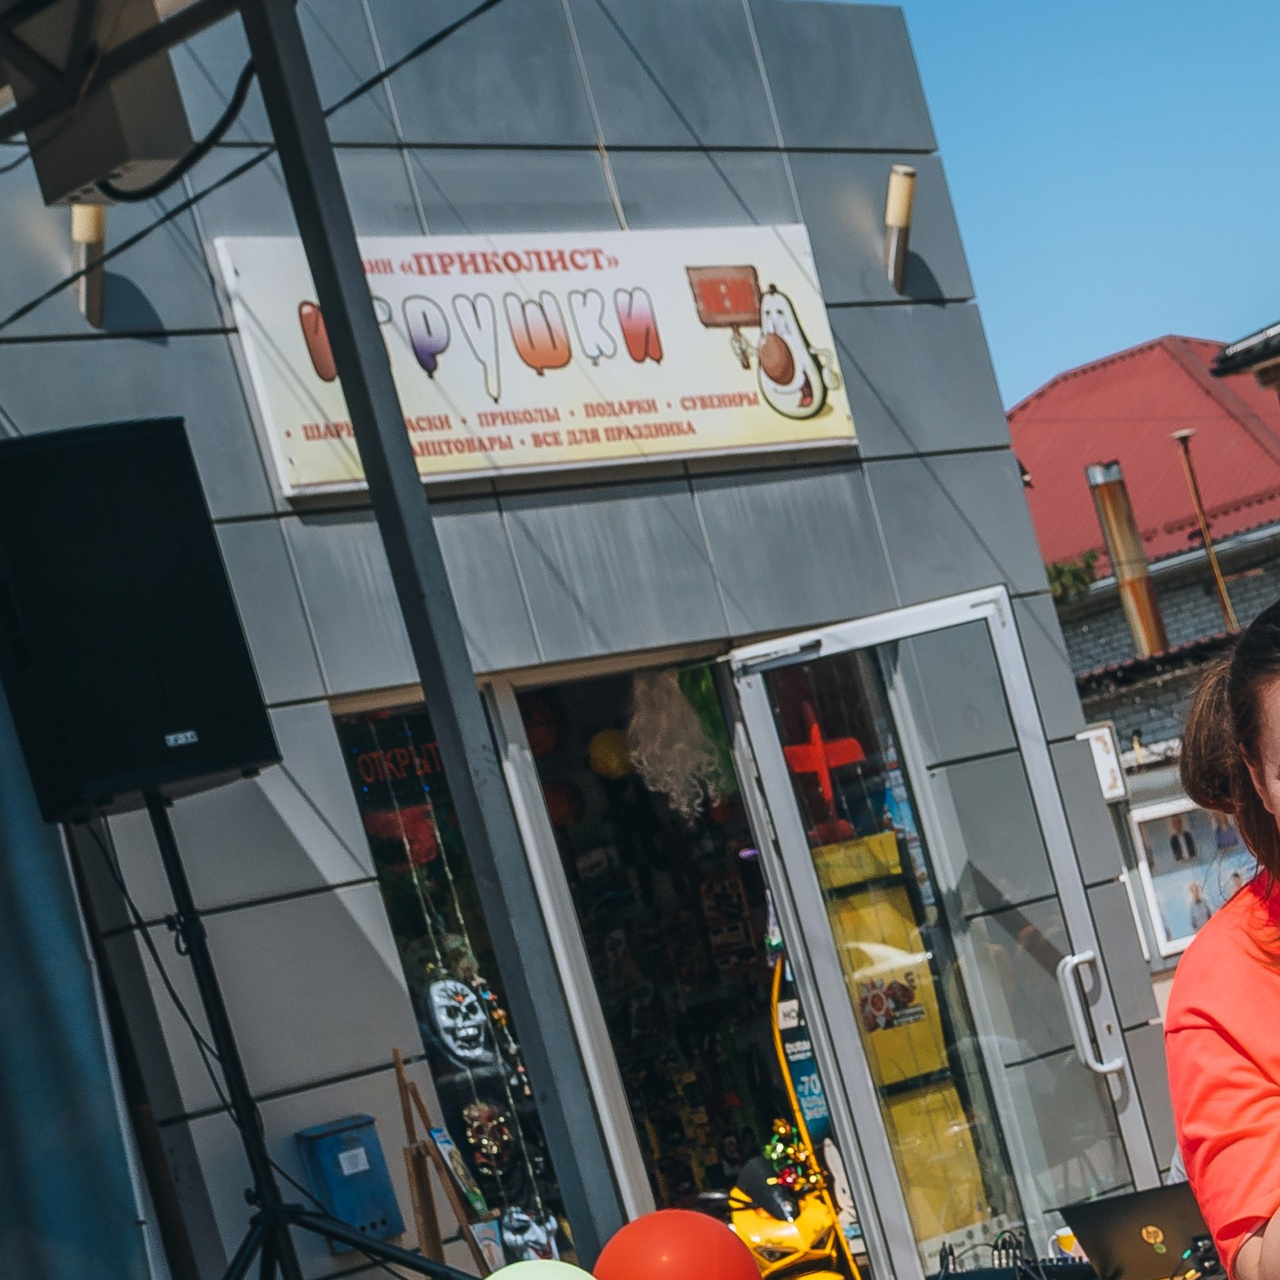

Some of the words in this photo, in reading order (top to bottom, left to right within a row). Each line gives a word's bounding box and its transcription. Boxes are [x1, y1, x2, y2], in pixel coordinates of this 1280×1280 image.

[298, 287, 663, 404] ИРУШКИ
[403, 414, 453, 433] АСКИ
[477, 406, 561, 428] ПРИКОЛЫ
[583, 397, 659, 419] ПОДАРКИ
[680, 391, 760, 411] СУВЕНИРЫ
[530, 430, 564, 449] ВСЕ
[566, 427, 601, 446] ДЛЯ
[603, 420, 697, 443] ПРАЗДНИКА
[358, 741, 443, 783] ОТКРЫТ
